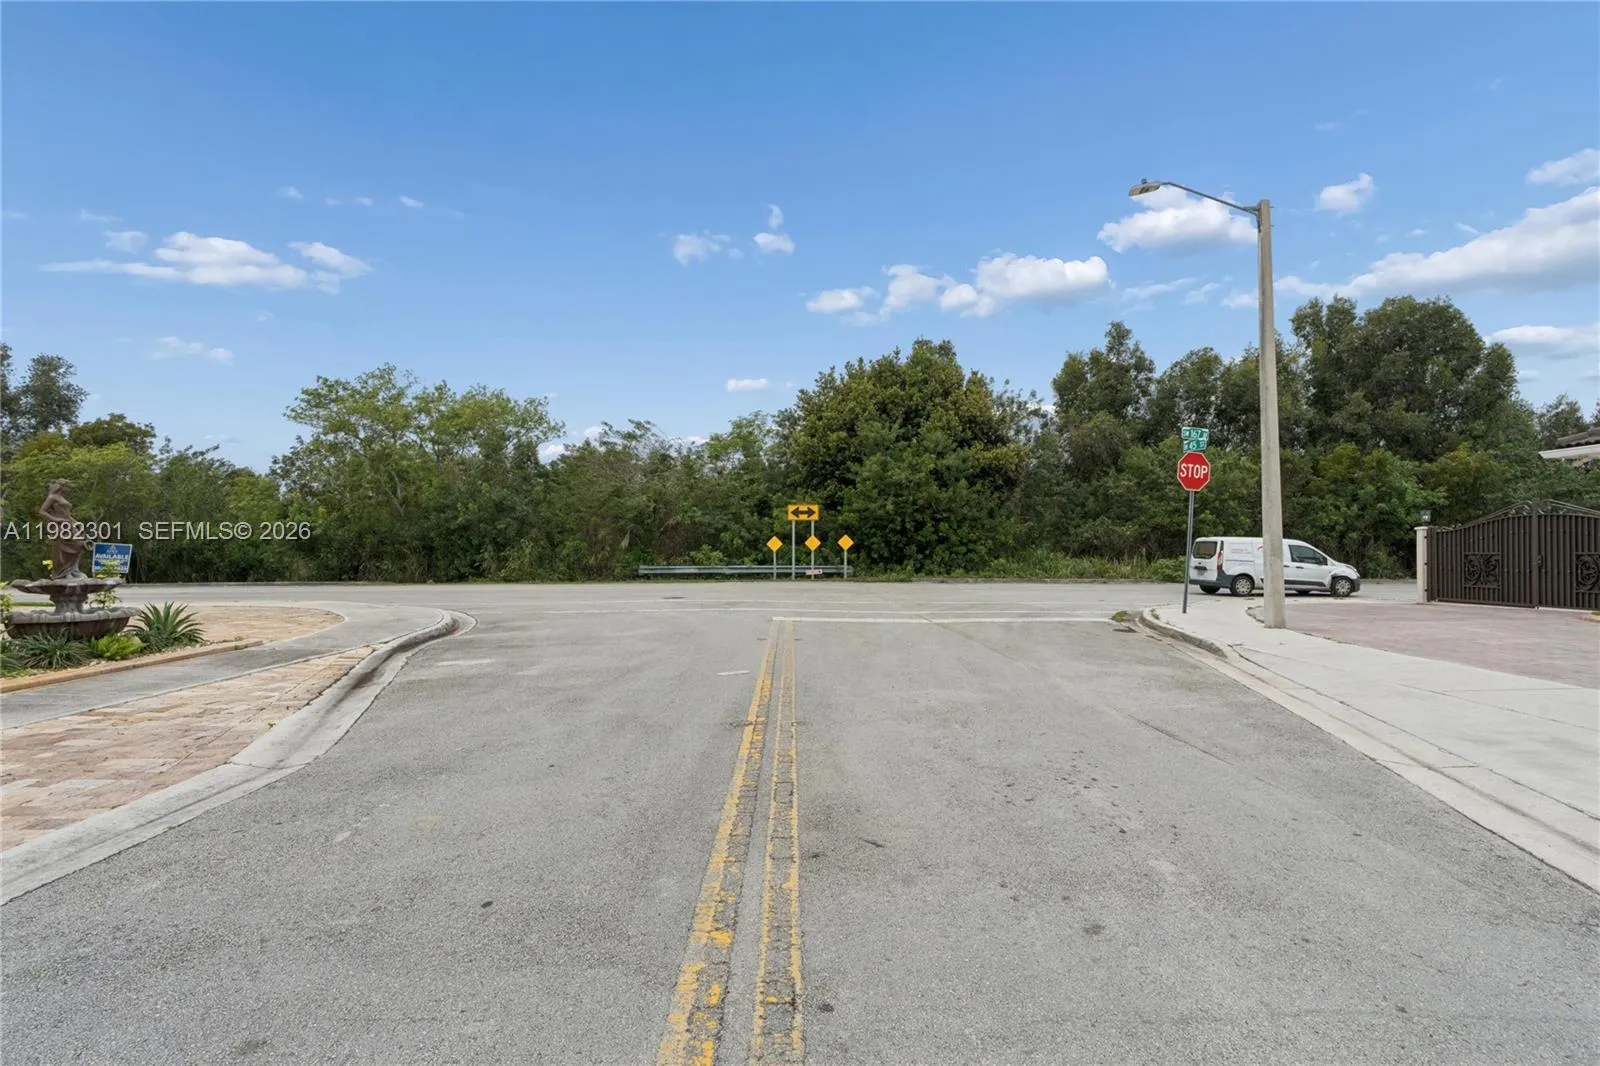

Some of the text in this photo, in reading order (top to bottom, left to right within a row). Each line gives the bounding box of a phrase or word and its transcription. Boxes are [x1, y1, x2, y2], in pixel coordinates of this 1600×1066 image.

[1190, 430, 1201, 438] 167
[1190, 441, 1197, 450] 45
[1180, 463, 1208, 479] STOP
